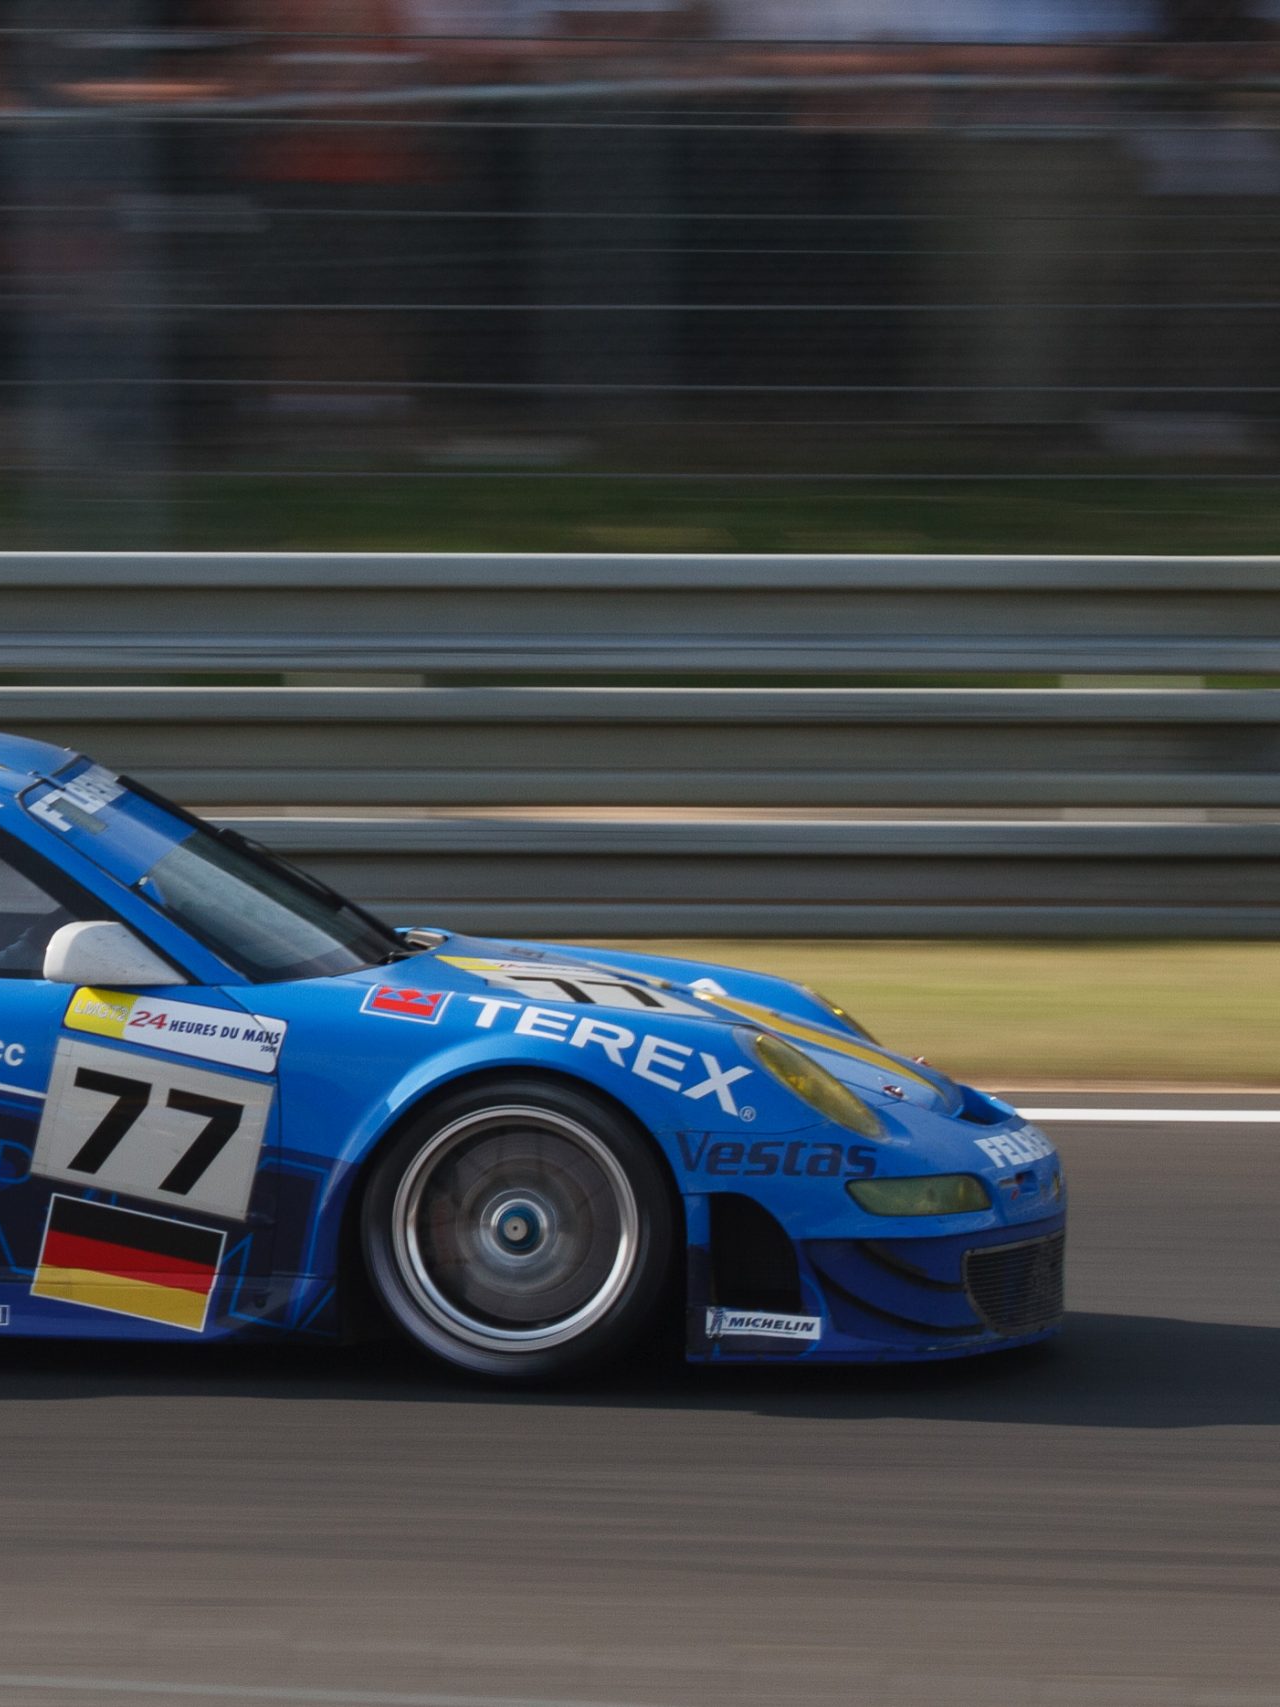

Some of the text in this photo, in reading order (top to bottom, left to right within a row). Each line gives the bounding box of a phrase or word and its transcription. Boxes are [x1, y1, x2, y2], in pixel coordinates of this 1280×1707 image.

[73, 999, 130, 1022] LMGT2
[129, 1010, 282, 1045] 24 HEURES DU MANS
[67, 1067, 245, 1196] 77
[677, 1131, 878, 1178] Vestas
[728, 1317, 816, 1332] MICHELIN
